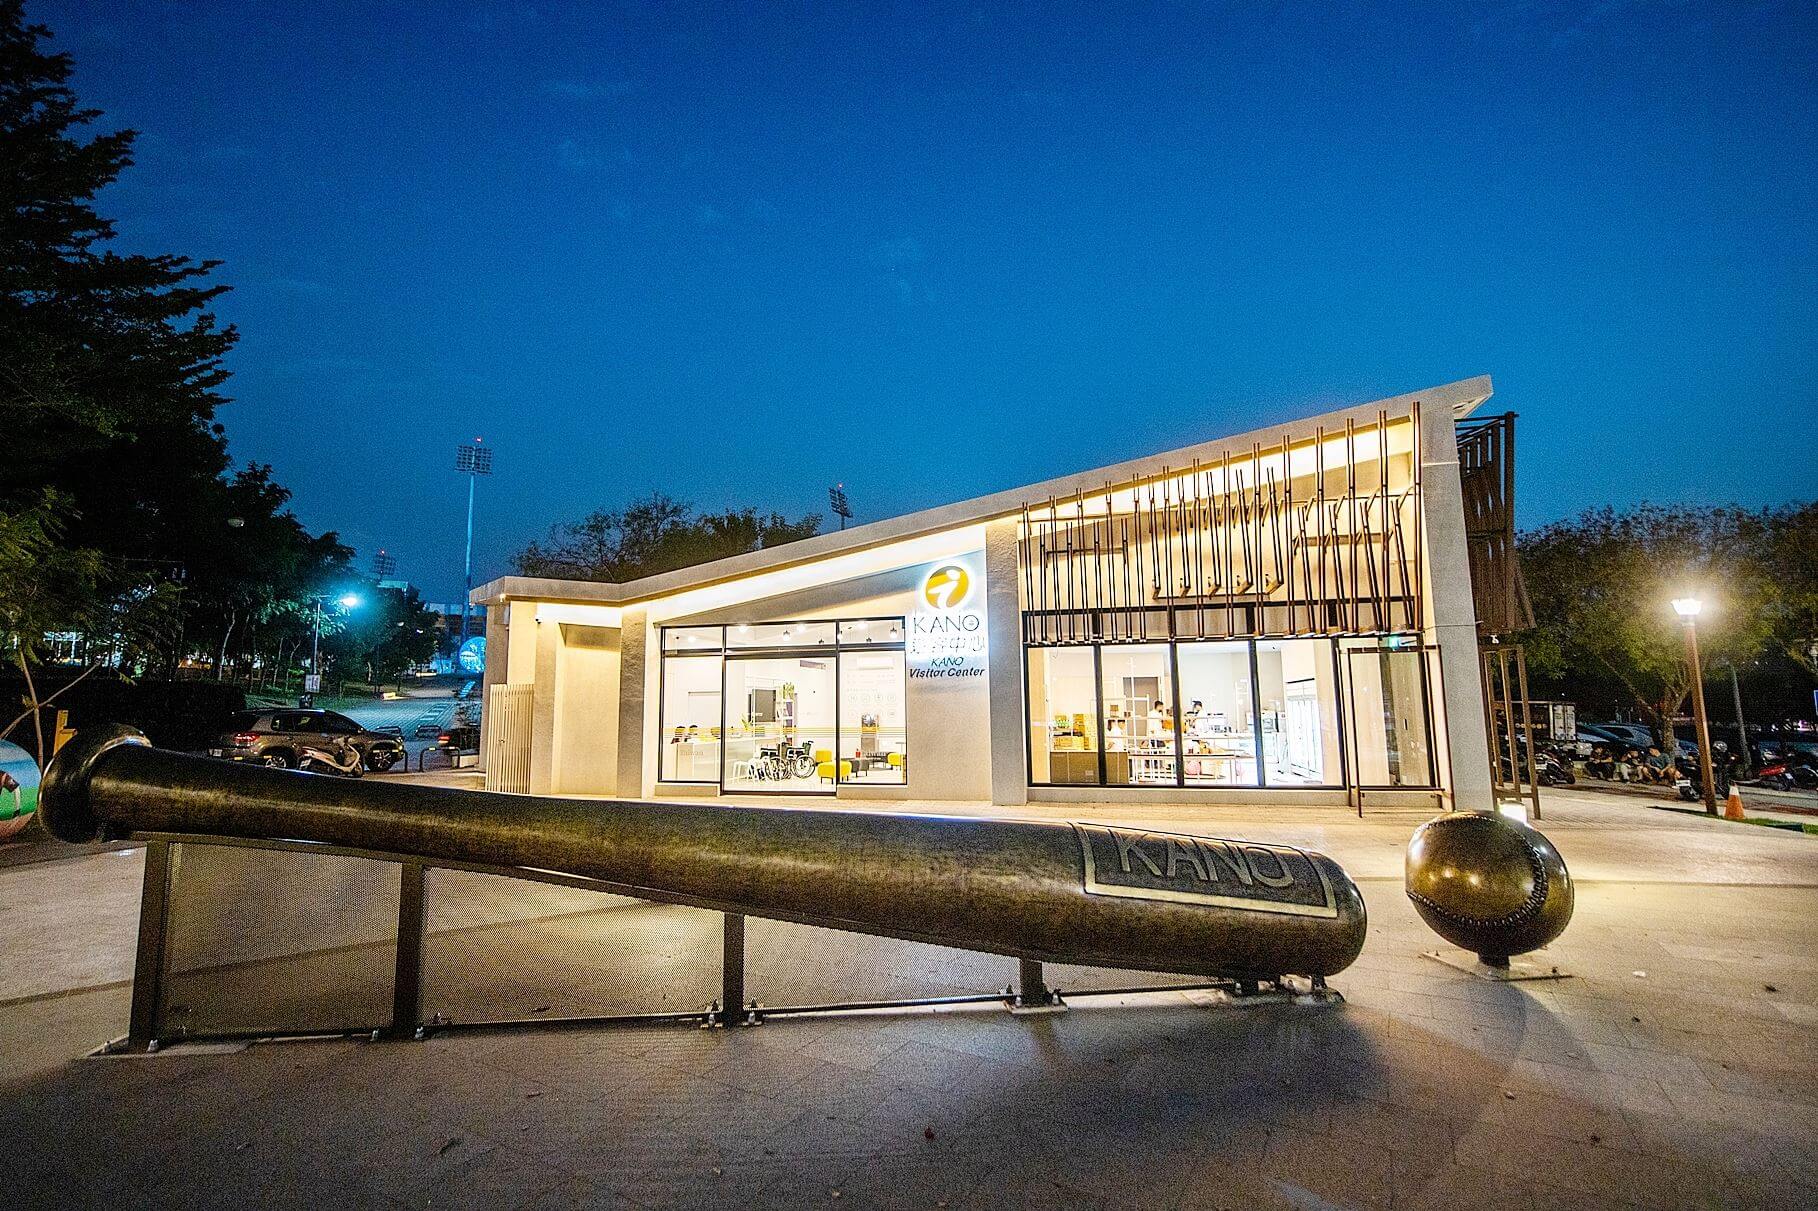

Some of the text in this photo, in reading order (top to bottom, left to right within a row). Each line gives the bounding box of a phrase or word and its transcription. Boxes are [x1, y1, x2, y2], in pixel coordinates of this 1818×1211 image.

[913, 614, 980, 634] KANO
[931, 656, 964, 667] KANO
[909, 667, 985, 679] Visitor Center
[1107, 828, 1294, 888] KANO
